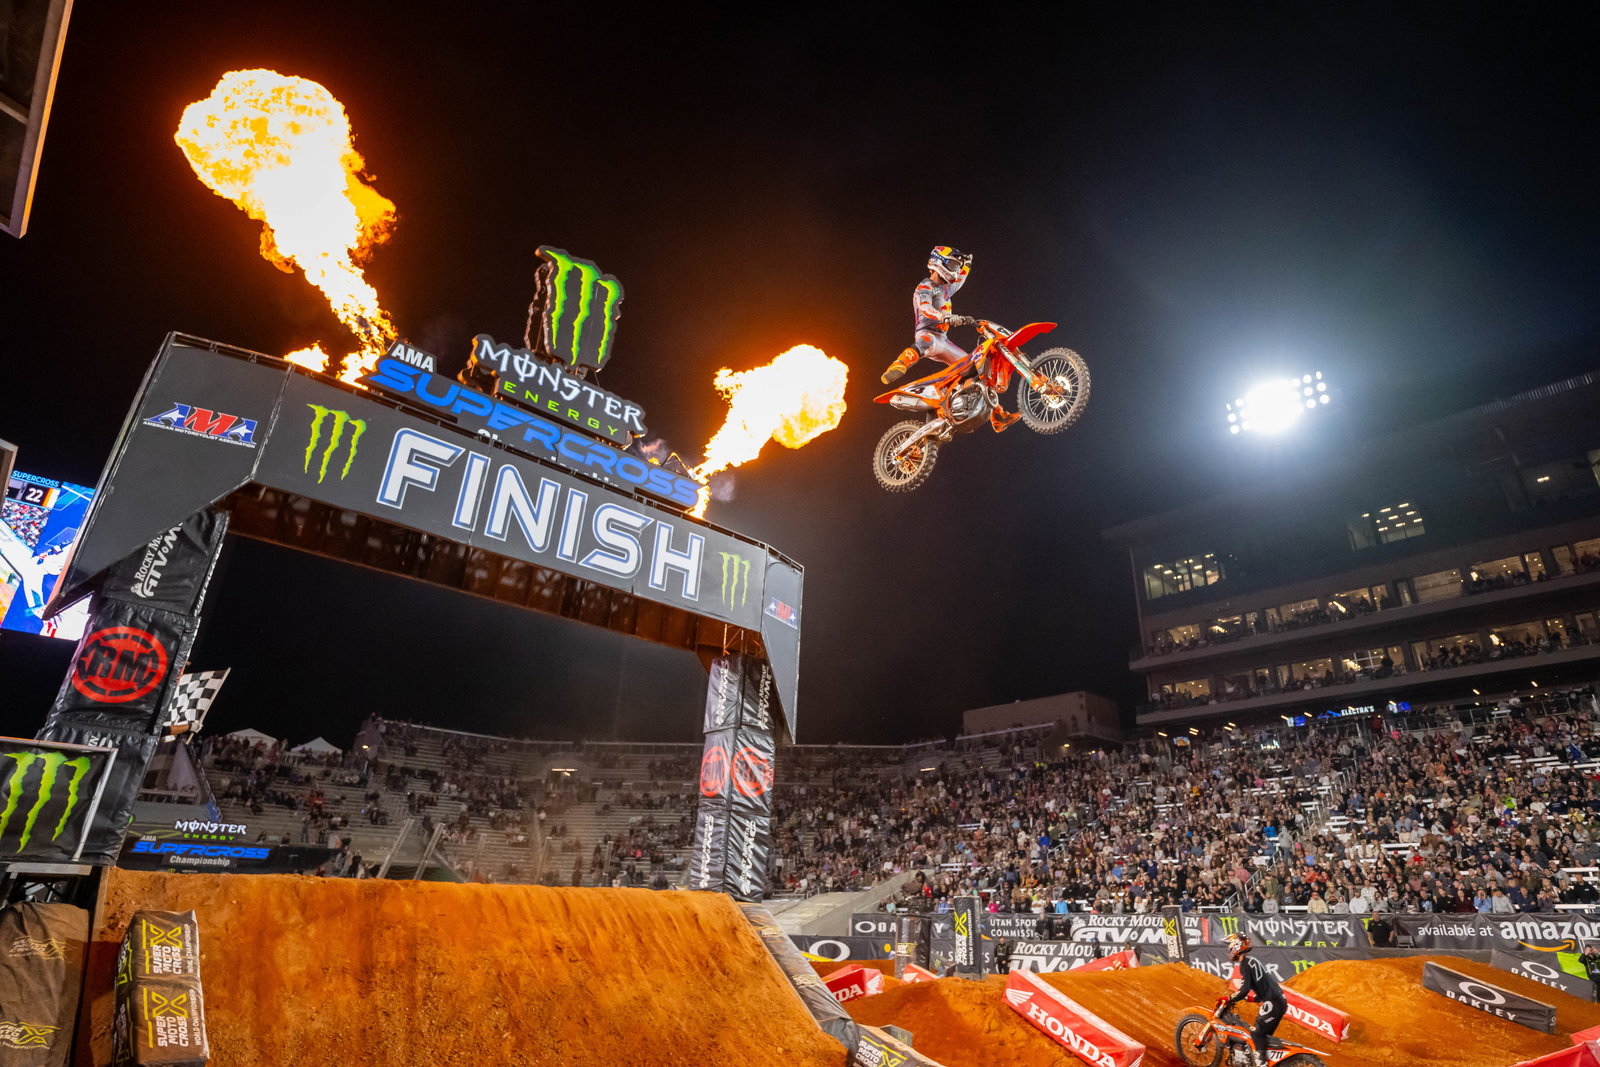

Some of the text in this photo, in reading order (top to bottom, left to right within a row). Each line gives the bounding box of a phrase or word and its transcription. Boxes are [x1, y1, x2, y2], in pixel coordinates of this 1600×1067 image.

[391, 343, 436, 373] AMA
[478, 338, 645, 432] MONSTER
[503, 381, 619, 437] ENERGY
[143, 402, 258, 445] AMA
[367, 357, 700, 508] SUPERCROSS
[12, 469, 60, 488] SUPERCROSS
[25, 487, 43, 503] 22
[376, 427, 706, 602] FINISH
[134, 550, 156, 582] ROCKY
[1341, 705, 1375, 717] ELECTRA'S
[141, 834, 157, 842] AMA
[174, 820, 247, 835] MONSTER
[131, 841, 271, 860] SUPERCROSS
[169, 855, 231, 867] Championship
[990, 918, 1012, 927] UTAH
[1087, 914, 1127, 927] ROCKY
[1247, 917, 1354, 938] MONSTER
[1418, 924, 1476, 937] available
[1479, 925, 1494, 937] at
[162, 945, 173, 973] MOTO
[1013, 941, 1057, 956] ROCKY
[1511, 967, 1568, 992] OAKLEY
[1446, 989, 1517, 1022] OAKLEY
[157, 1015, 168, 1047] SUPER
[166, 1016, 178, 1045] MOTO
[177, 1015, 190, 1048] CROSS
[1286, 1004, 1338, 1038] NDA
[1026, 1002, 1116, 1067] HONDA
[857, 1047, 880, 1063] MOTO
[858, 1040, 883, 1058] SUPER
[1270, 1050, 1284, 1060] 711
